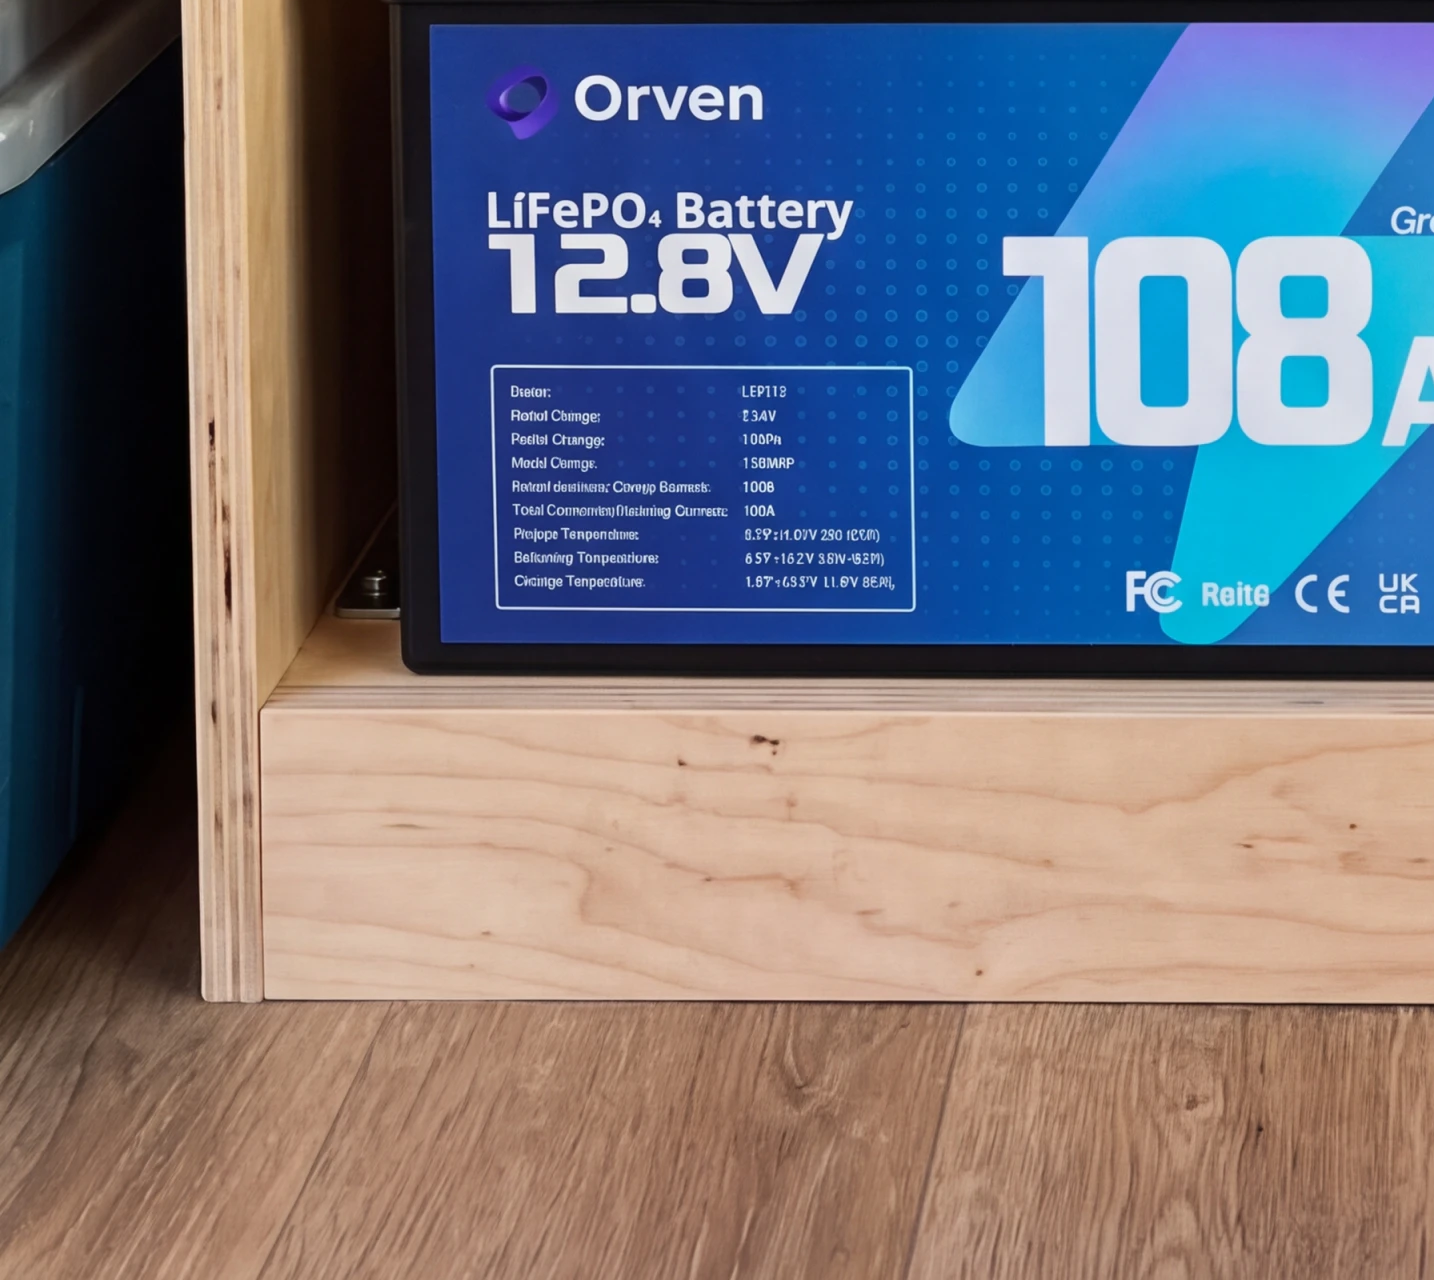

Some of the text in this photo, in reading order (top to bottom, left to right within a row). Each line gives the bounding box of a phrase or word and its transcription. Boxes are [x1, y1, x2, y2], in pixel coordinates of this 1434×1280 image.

[574, 74, 764, 121] Orven
[675, 191, 855, 241] Battery
[488, 233, 826, 315] 12.8V
[1002, 236, 1374, 447] 108
[744, 504, 776, 517] 100A
[1295, 574, 1351, 613] CE
[1379, 573, 1418, 593] UK
[1379, 594, 1420, 614] CA
